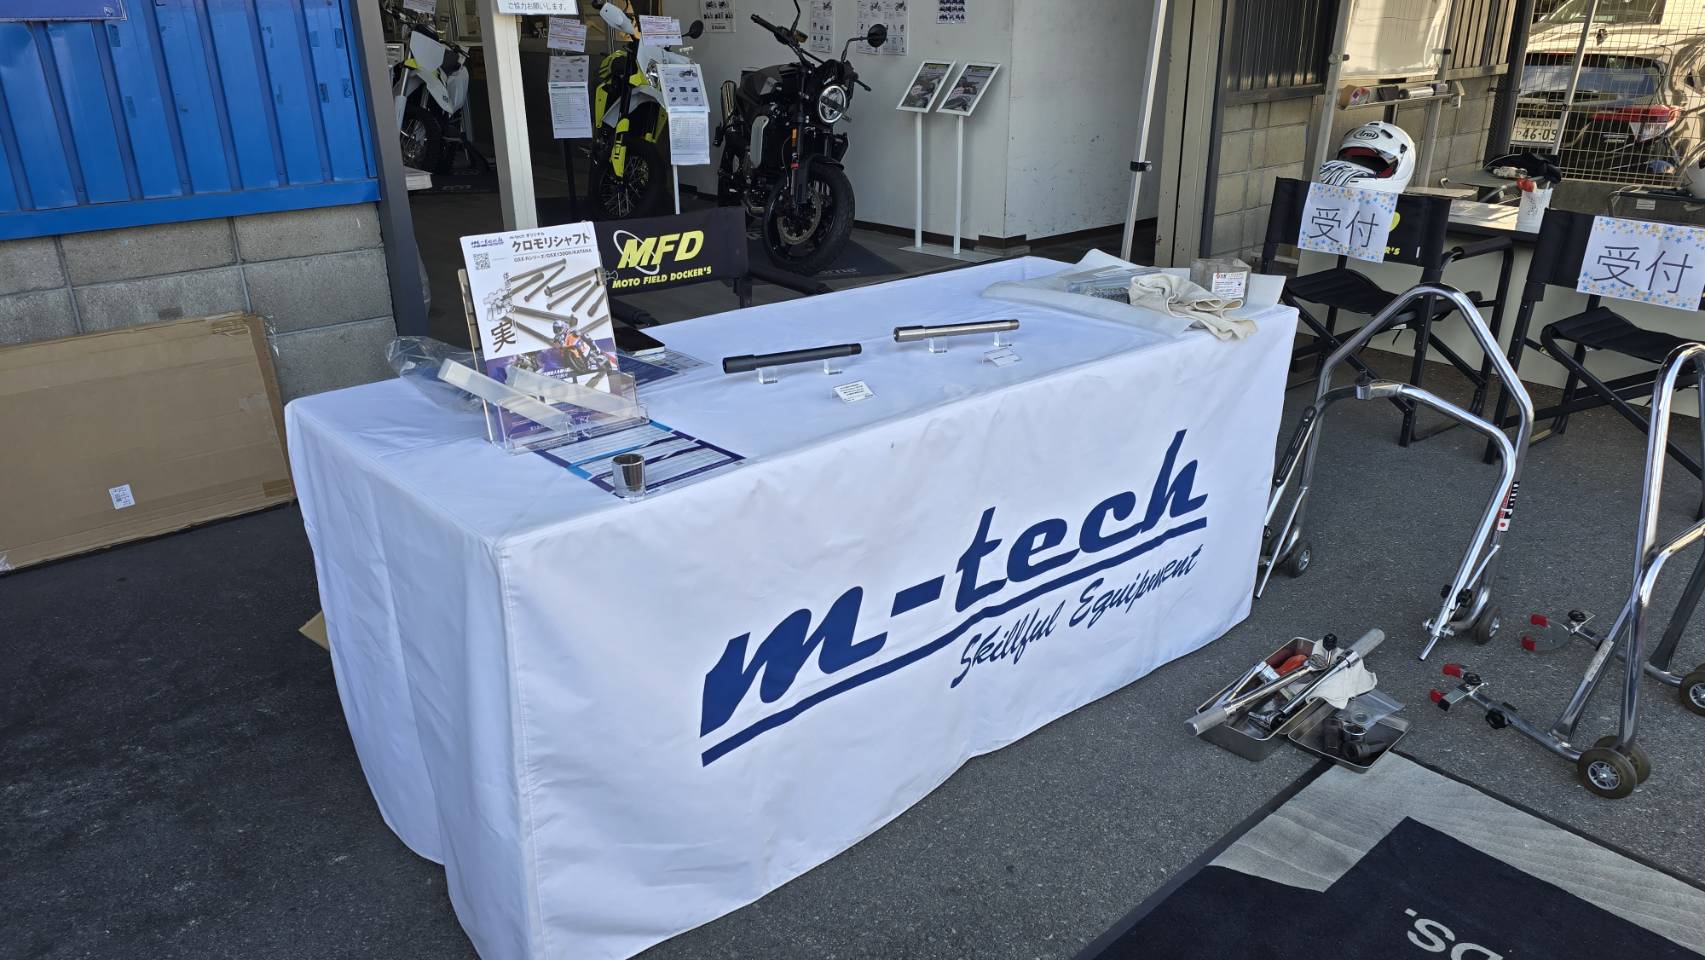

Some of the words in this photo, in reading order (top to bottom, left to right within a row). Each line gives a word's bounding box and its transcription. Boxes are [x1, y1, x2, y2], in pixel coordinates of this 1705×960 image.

[1522, 128, 1558, 141] 46-09
[512, 232, 591, 252] クロモリシャフト
[1309, 207, 1379, 248] 受付
[617, 230, 705, 269] MFD
[1593, 245, 1694, 294] 受付
[612, 278, 642, 289] MOTO
[643, 274, 668, 285] FIELD
[670, 265, 712, 281] DOCKER'S
[700, 429, 1208, 738] m-tech
[951, 602, 1065, 689] Skillful
[1069, 544, 1204, 629] Equipment
